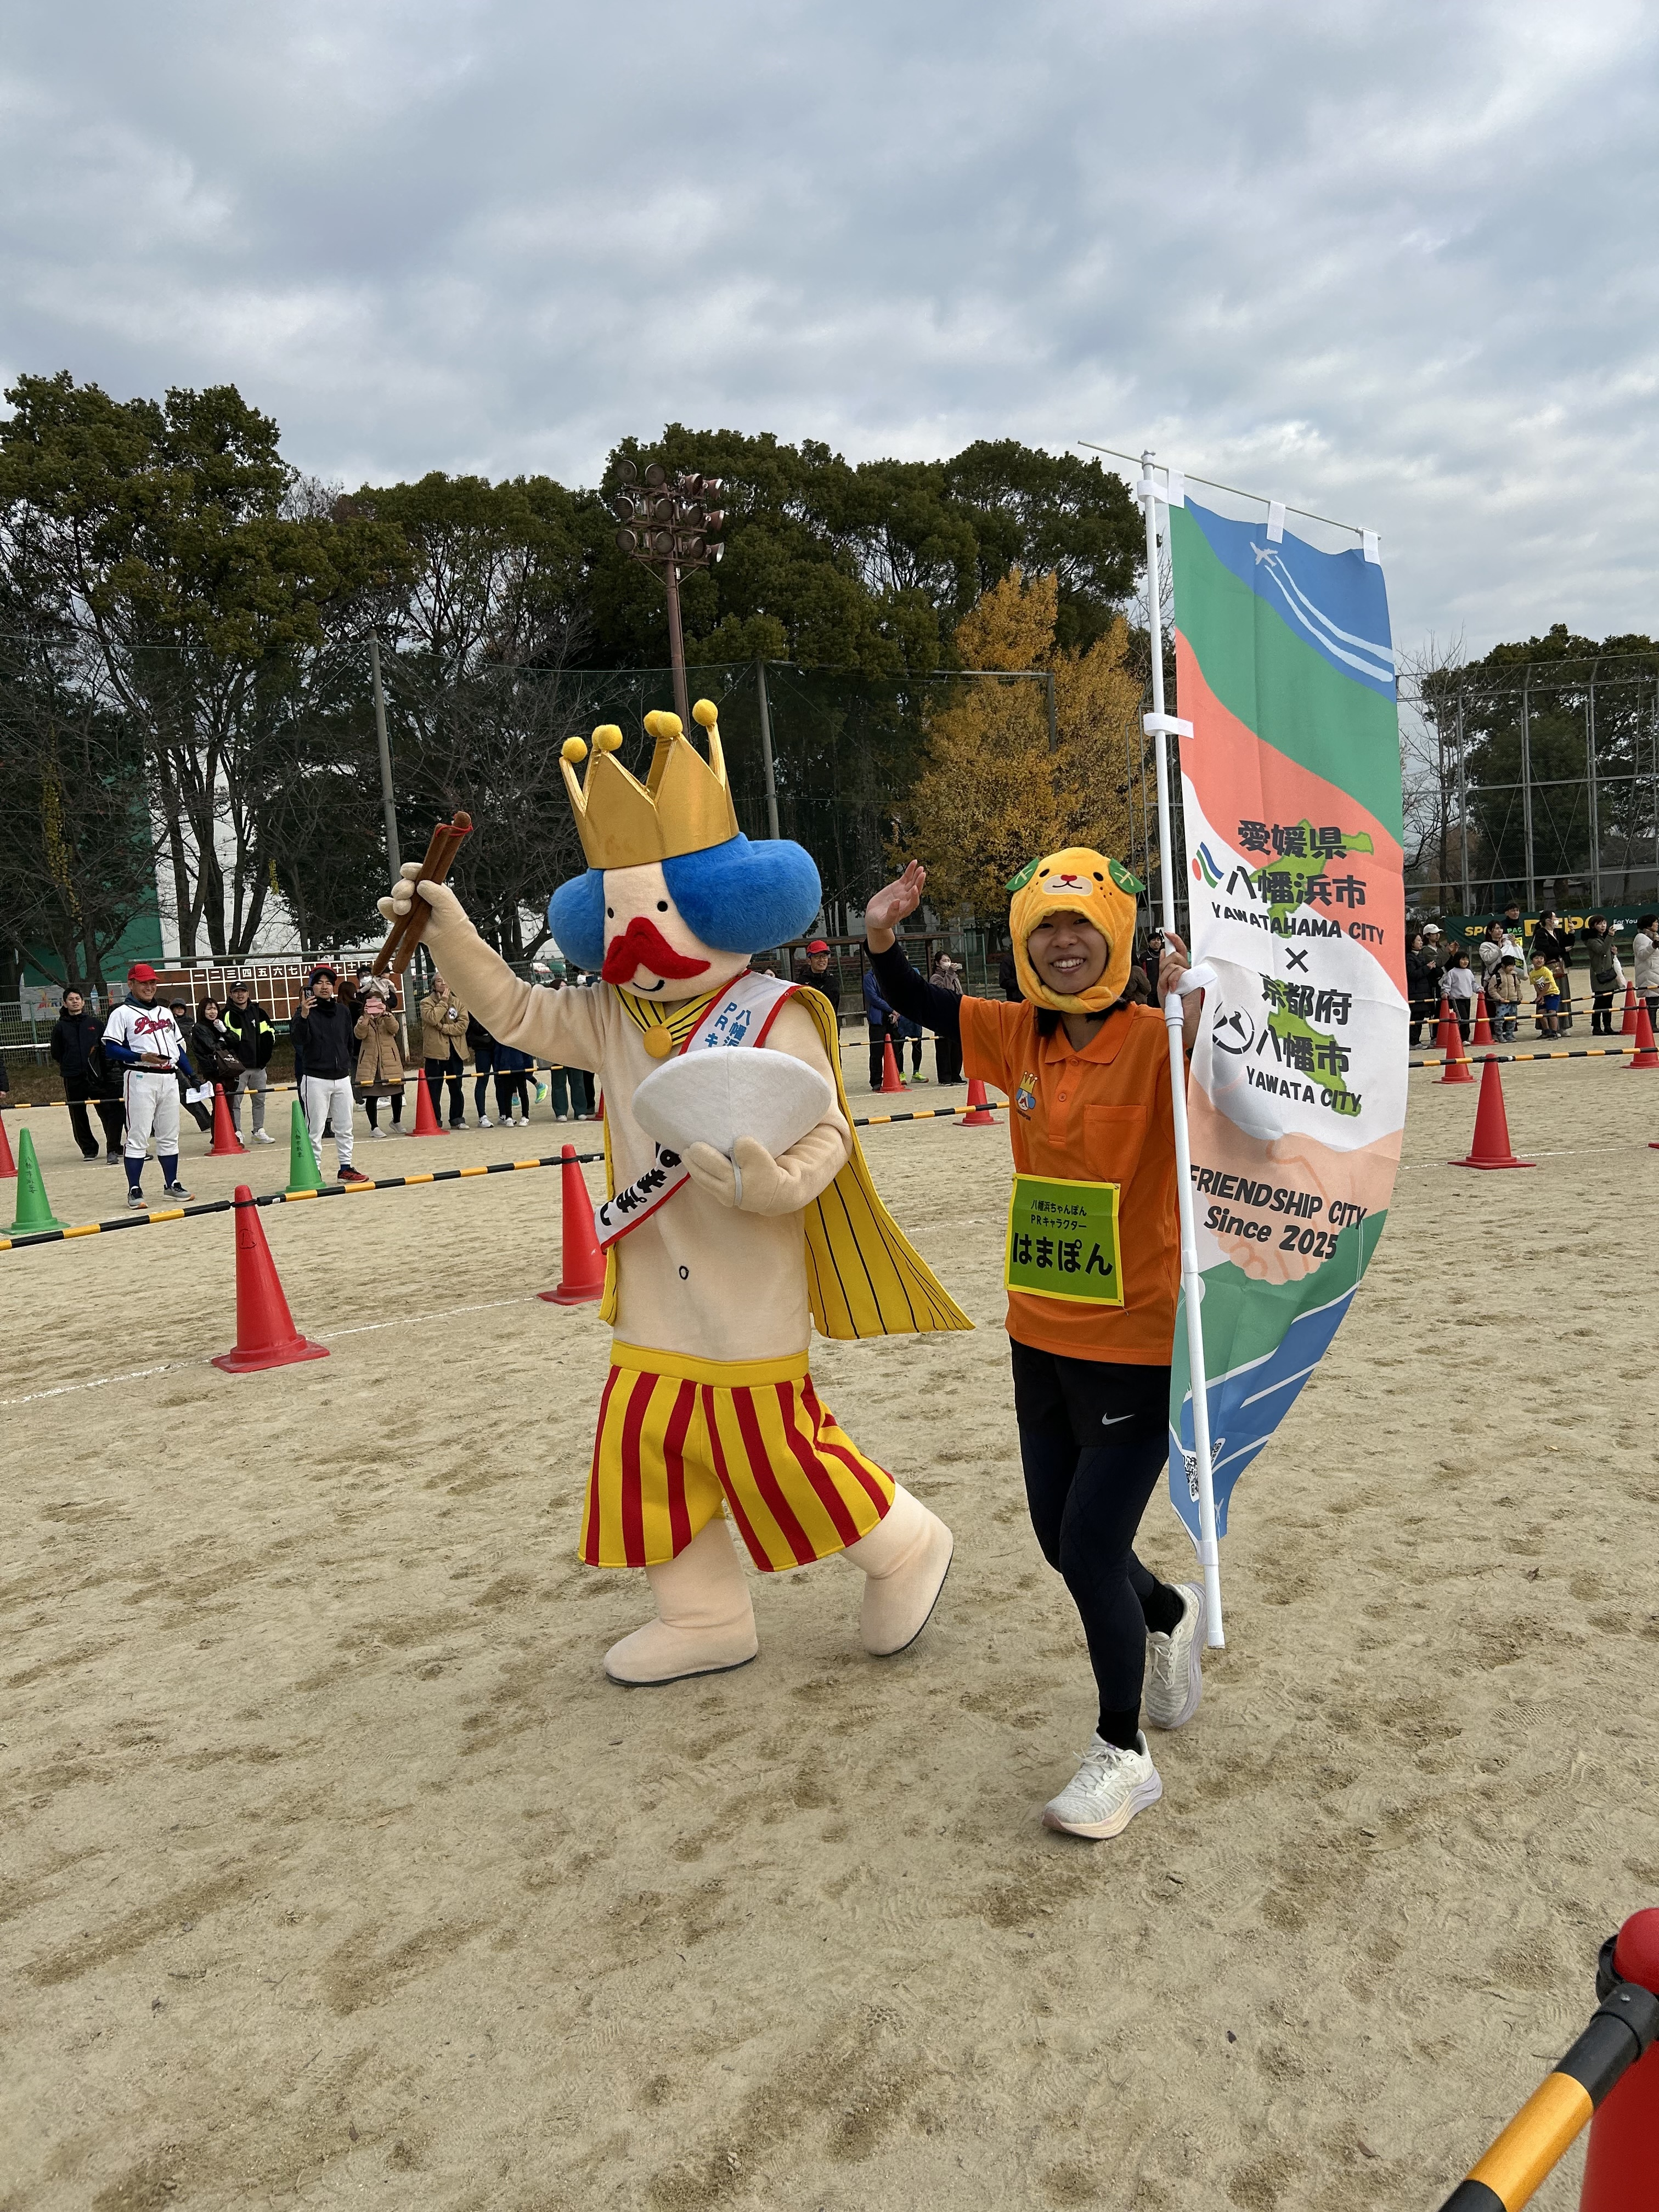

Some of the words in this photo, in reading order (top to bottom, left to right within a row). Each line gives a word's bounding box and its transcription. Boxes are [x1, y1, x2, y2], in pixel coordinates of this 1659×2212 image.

[1238, 820, 1347, 860] 愛媛県
[1226, 866, 1367, 909] 八幡浜市
[1211, 901, 1342, 938] YAWATAHAMA
[1348, 922, 1384, 945] CITY
[210, 970, 221, 979] 二
[226, 969, 237, 979] 三
[242, 968, 252, 978] 四
[257, 968, 268, 977] 五
[273, 966, 283, 976] 六
[288, 966, 298, 975] 七
[303, 965, 312, 974] 八
[332, 963, 342, 973] 十
[1257, 972, 1352, 1025] 京都府
[1256, 1024, 1351, 1076] 八幡市
[1246, 1065, 1315, 1104] YAWATA
[1321, 1088, 1362, 1113] CITY
[1030, 1199, 1087, 1217] 八幡浜ちゃんぽん
[1030, 1214, 1087, 1231] PRキャラクター
[1328, 1200, 1368, 1230] CITY
[1204, 1205, 1272, 1243] Since
[1278, 1224, 1339, 1260] 2025
[1013, 1232, 1114, 1277] はまぽん
